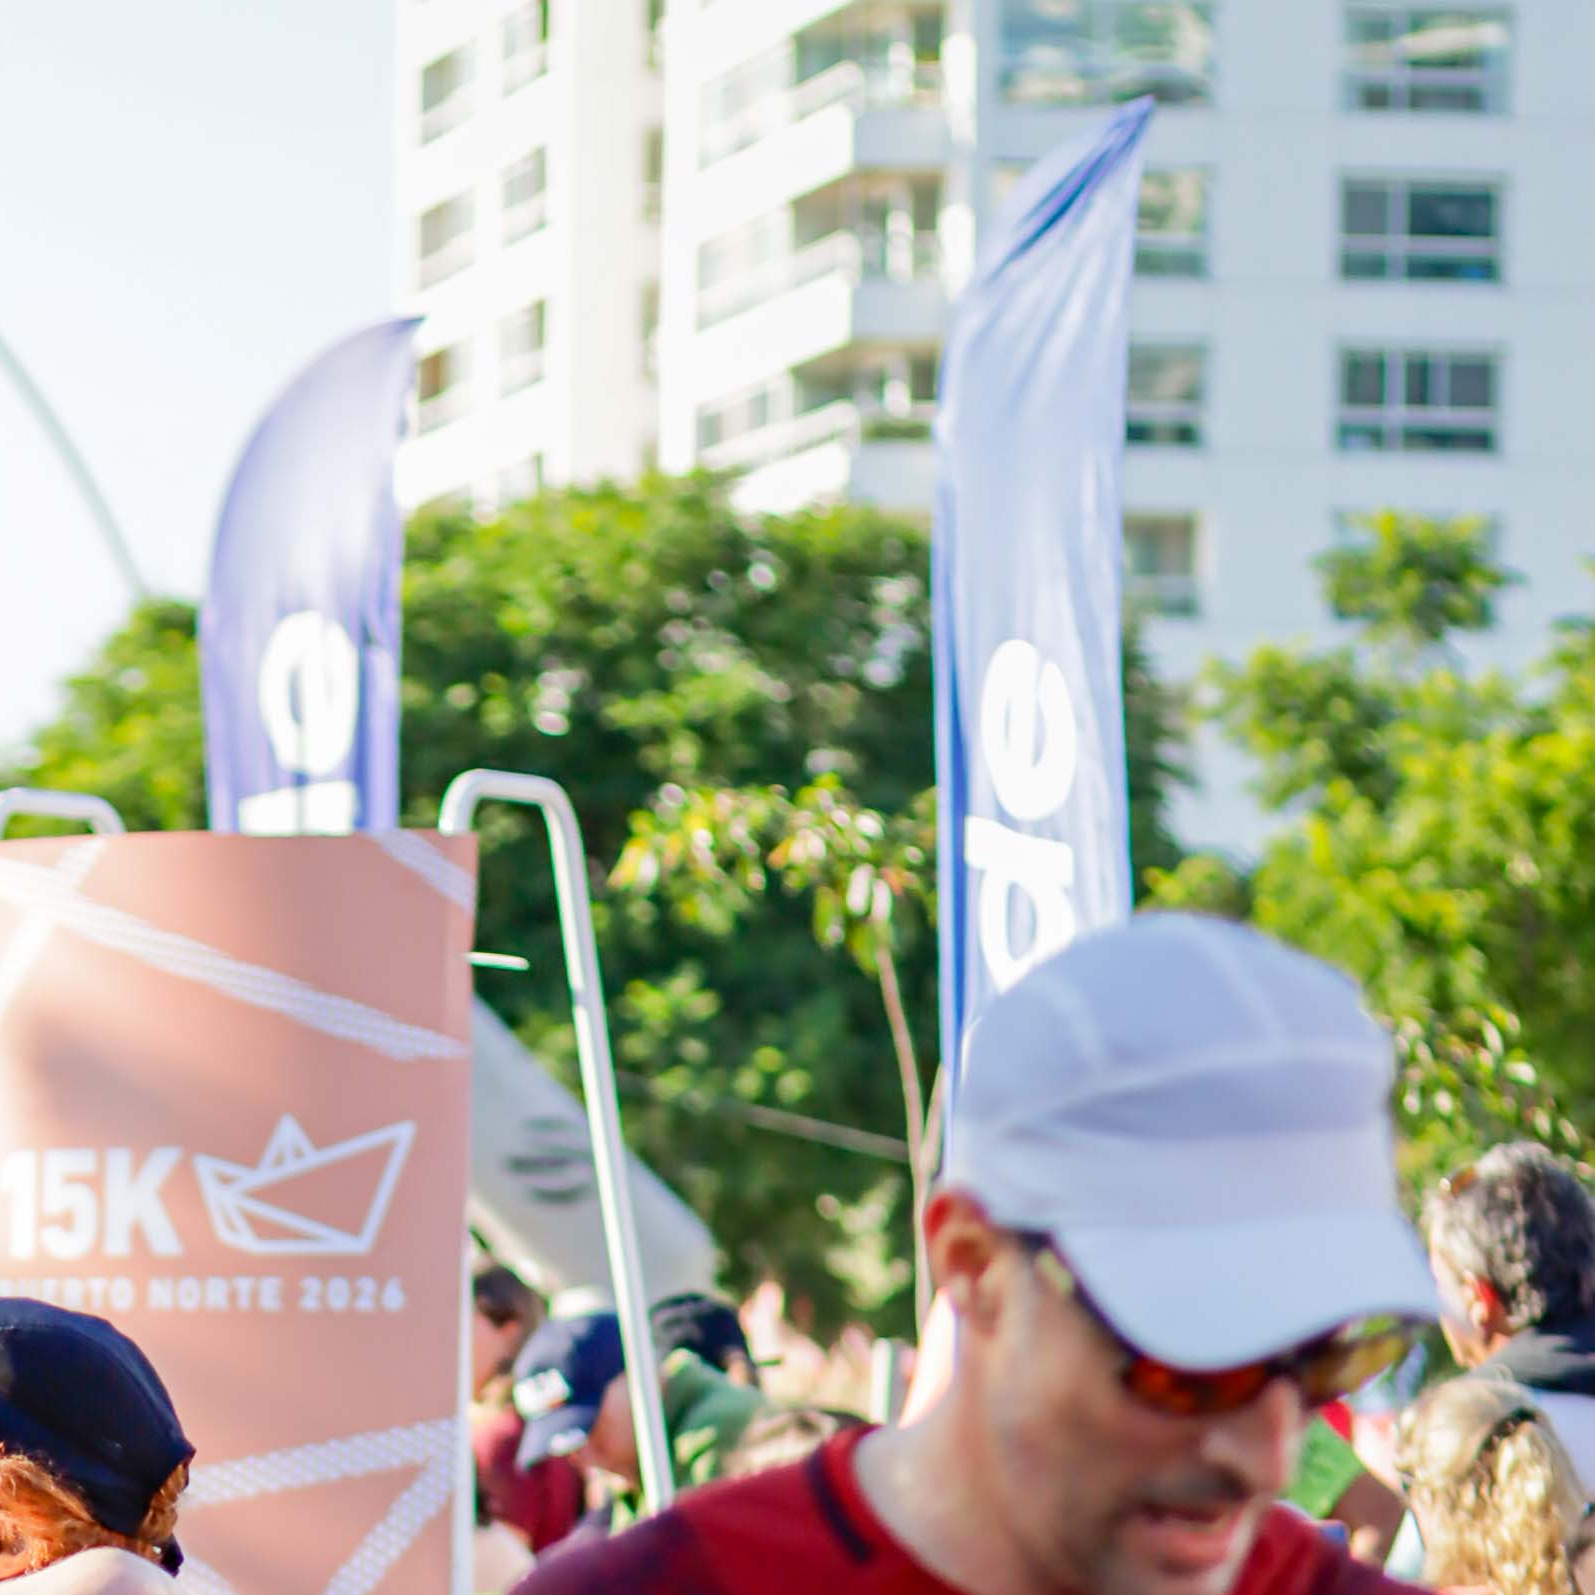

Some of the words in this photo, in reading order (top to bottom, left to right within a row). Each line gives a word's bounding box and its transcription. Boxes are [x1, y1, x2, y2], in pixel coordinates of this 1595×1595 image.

[964, 639, 1077, 993] de
[147, 1276, 284, 1313] NORTE
[298, 1276, 406, 1313] 2026
